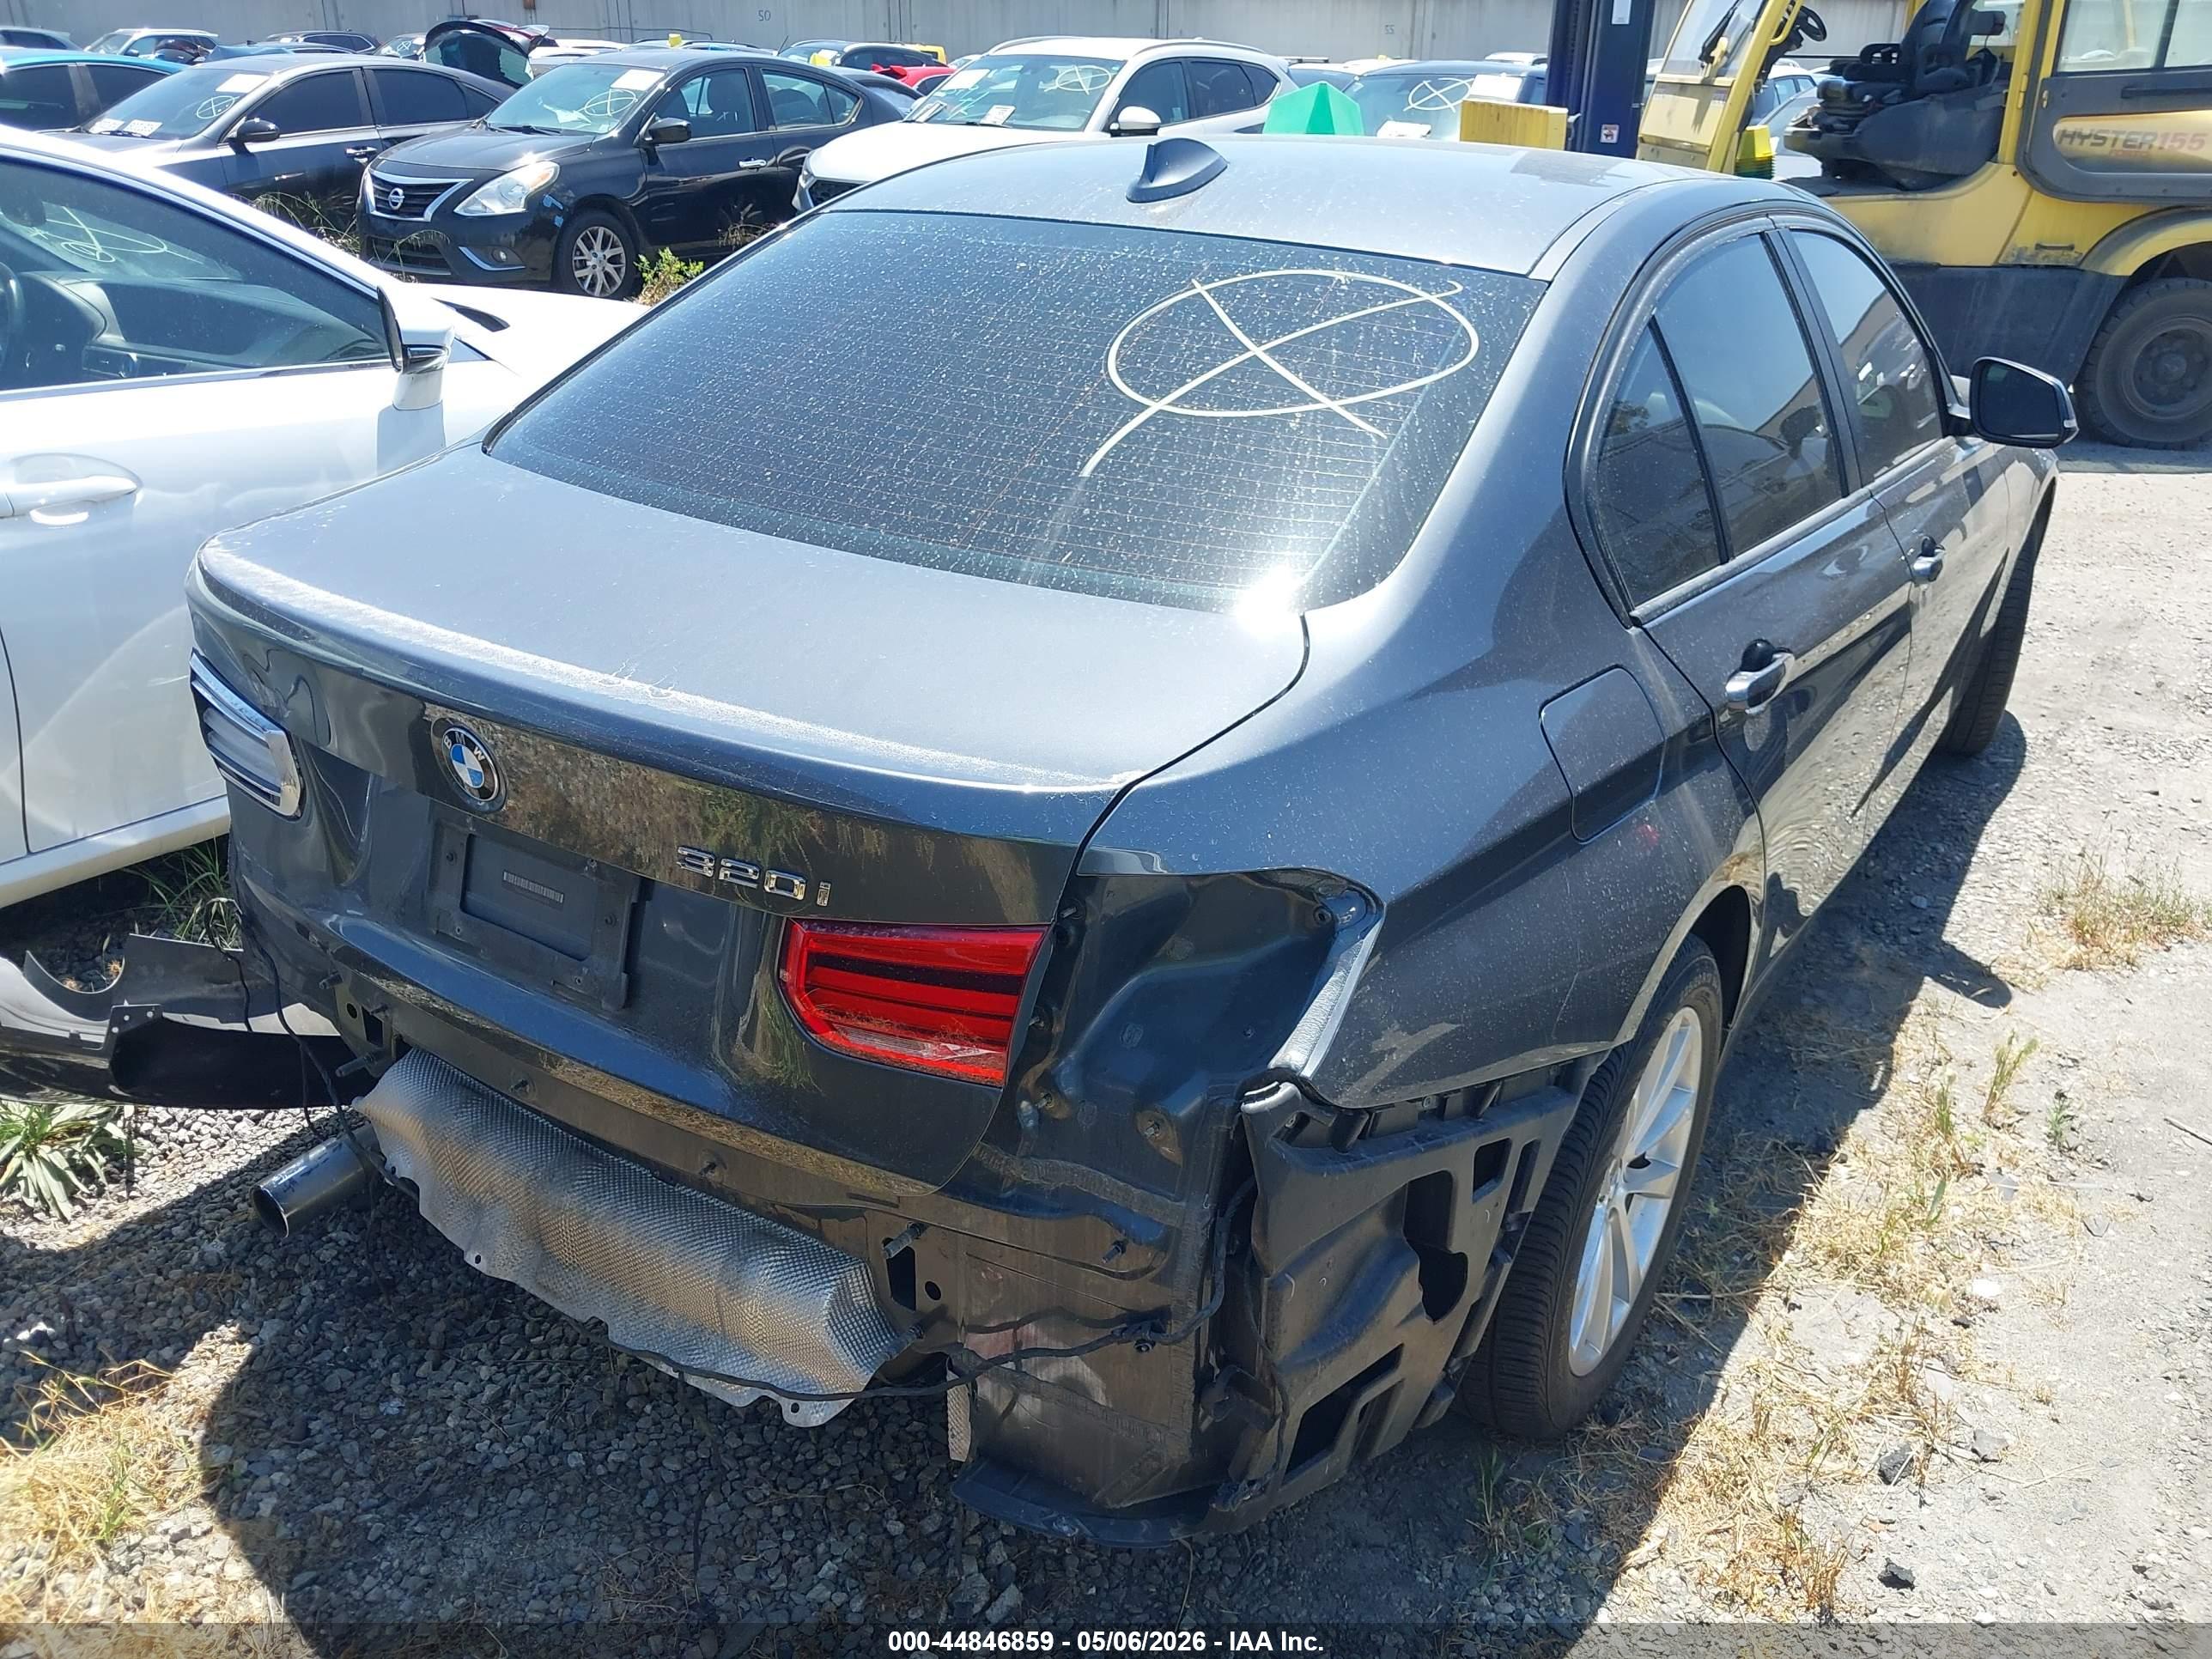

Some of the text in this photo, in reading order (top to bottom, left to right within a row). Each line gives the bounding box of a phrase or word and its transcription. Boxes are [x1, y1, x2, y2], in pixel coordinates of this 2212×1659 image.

[2057, 128, 2209, 151] HYSTER 155
[443, 731, 486, 762] BMW
